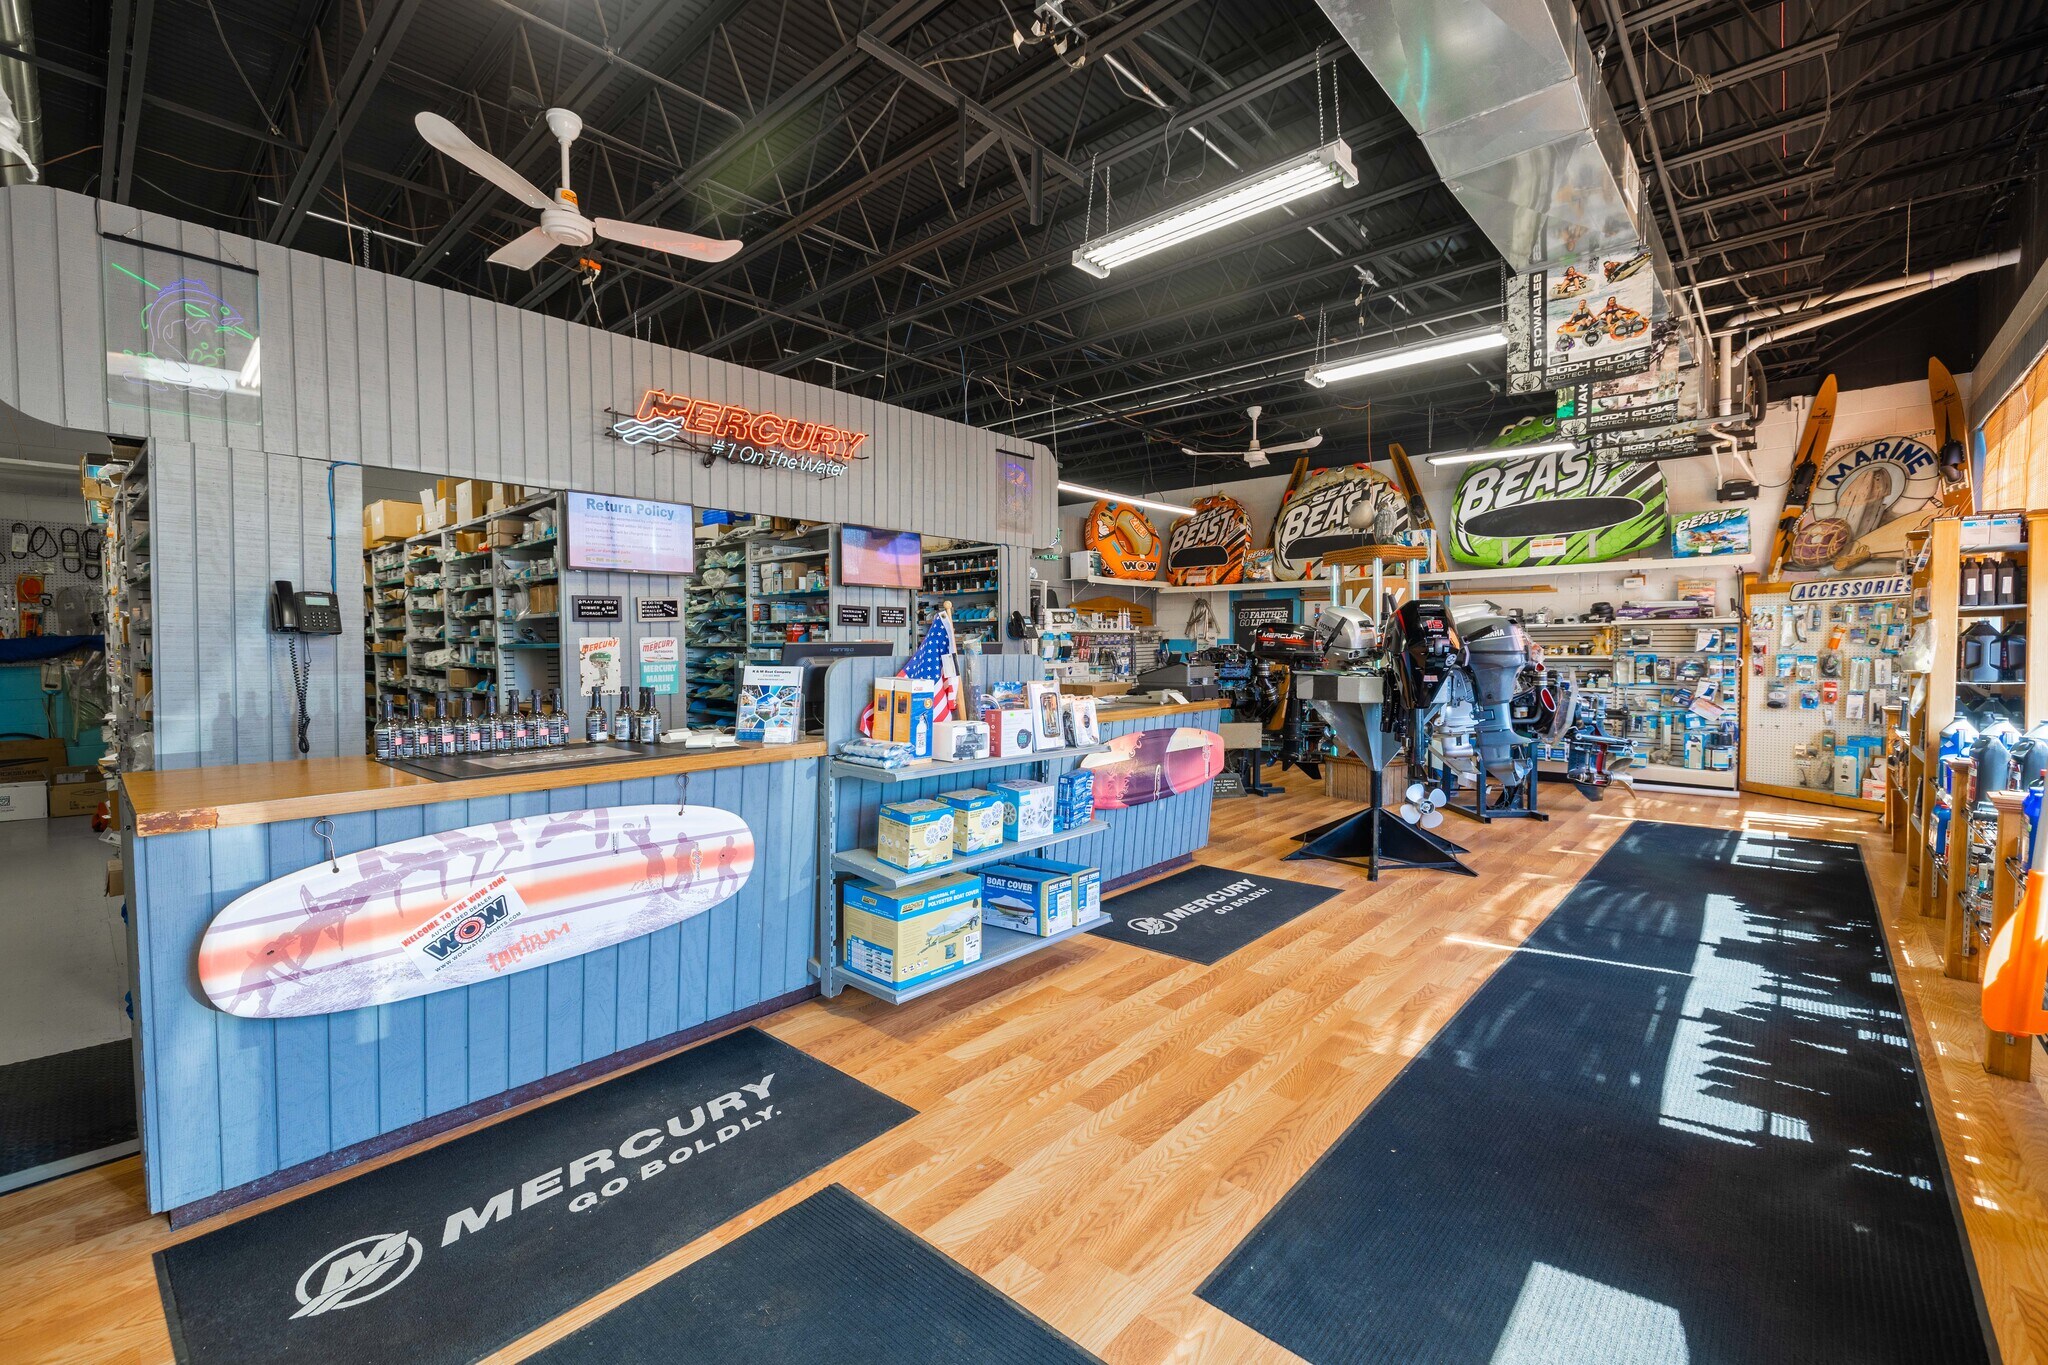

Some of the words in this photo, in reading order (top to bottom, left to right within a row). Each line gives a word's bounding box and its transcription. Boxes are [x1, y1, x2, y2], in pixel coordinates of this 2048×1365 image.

[1532, 273, 1542, 347] TOWABLES
[1546, 360, 1593, 377] BODY
[1594, 349, 1648, 366] GLOVE
[1545, 369, 1590, 383] PROTECT
[1592, 365, 1609, 374] THE
[1591, 412, 1628, 423] BODY
[1631, 403, 1674, 417] GLOVE
[637, 391, 867, 460] MERCURY
[1590, 419, 1628, 428] PROTECT
[1622, 442, 1656, 452] BODY
[1657, 436, 1695, 447] GLOVE
[711, 440, 736, 459] #1
[739, 446, 765, 465] On
[768, 450, 798, 469] The
[800, 455, 848, 477] Water
[1826, 443, 1934, 487] MARINE
[586, 498, 632, 514] Return
[636, 503, 675, 521] Policy
[1190, 506, 1223, 525] SEA
[1169, 510, 1235, 552] BEAST
[1676, 510, 1729, 536] BEAST
[1121, 561, 1158, 572] WOW
[1239, 611, 1249, 619] GO
[1250, 610, 1288, 619] FARTHER
[1240, 619, 1250, 627] GO
[1426, 619, 1444, 629] 15
[1262, 632, 1304, 640] MERCURY
[581, 640, 617, 653] MERCURY
[643, 640, 675, 652] MERCURY
[643, 664, 677, 673] MERCURY
[646, 675, 674, 683] MARINE
[986, 876, 1007, 887] BOAT
[1007, 880, 1033, 892] COVER
[928, 895, 953, 907] POLYESTER
[953, 892, 965, 901] BOAT
[965, 888, 980, 897] COVER
[1163, 878, 1257, 922] MERCURY
[401, 919, 439, 948] WELCOME
[440, 912, 452, 924] TO
[452, 900, 468, 915] THE
[467, 888, 489, 905] WOW
[489, 875, 507, 891] ZONE
[431, 910, 469, 939] AUTHORIZED
[469, 896, 493, 914] DEALER
[1214, 905, 1234, 915] GO
[423, 895, 509, 960] WOW
[434, 911, 522, 973] WWW.WOWWATERSPORTS.COM
[441, 1073, 776, 1247] MERCURY
[569, 1177, 629, 1213] GO
[641, 1104, 783, 1181] BOLDLY.
